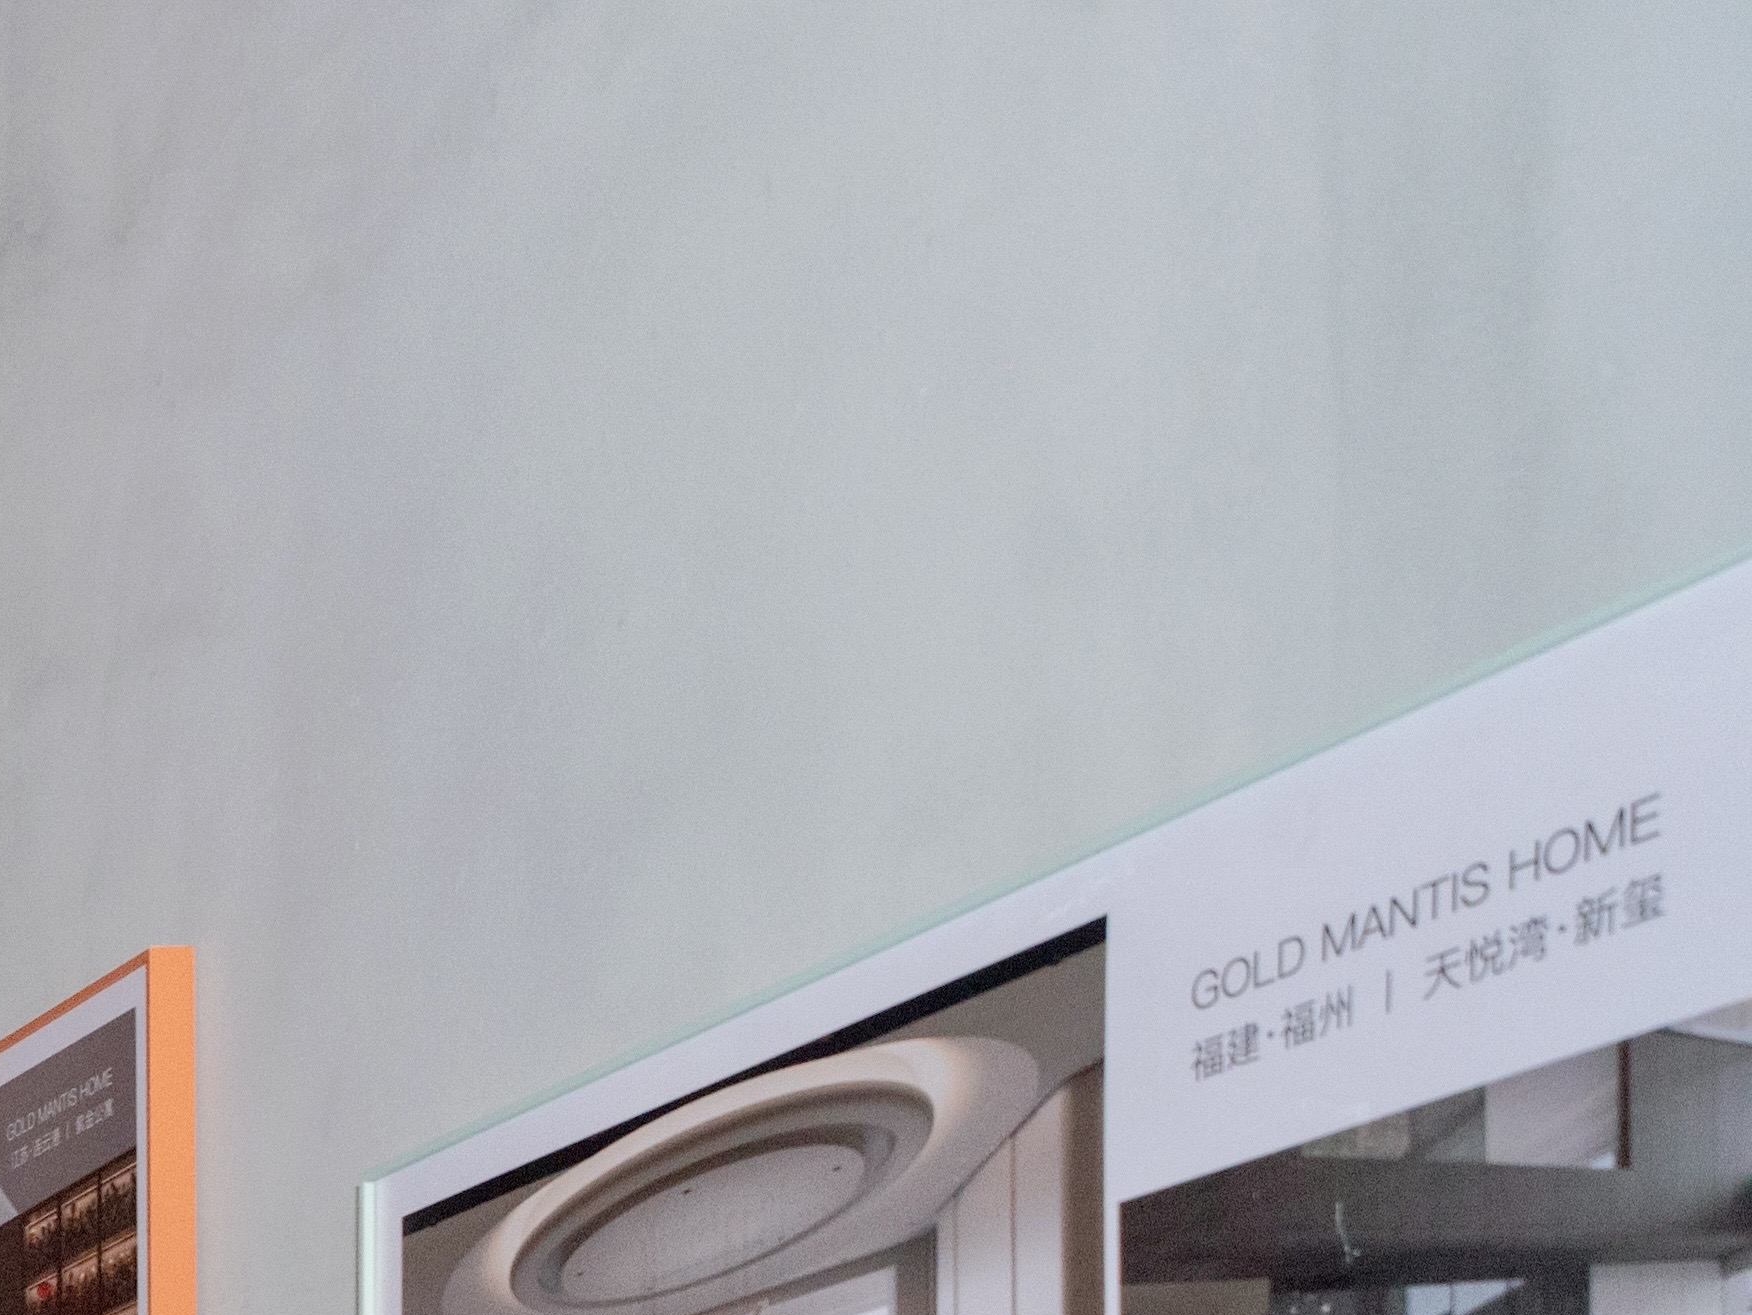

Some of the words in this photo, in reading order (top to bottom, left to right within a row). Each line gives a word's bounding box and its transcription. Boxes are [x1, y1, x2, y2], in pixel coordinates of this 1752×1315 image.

[1189, 984, 1355, 1082] 福建·福州
[1423, 873, 1667, 1001] 天悦湾·新玺
[1190, 936, 1305, 1010] GOLD
[1319, 861, 1491, 963] MANTIS
[1507, 792, 1662, 890] HOME
[6, 1111, 36, 1142] GOLD
[36, 1087, 79, 1125] MANTIS
[78, 1067, 114, 1101] HOME
